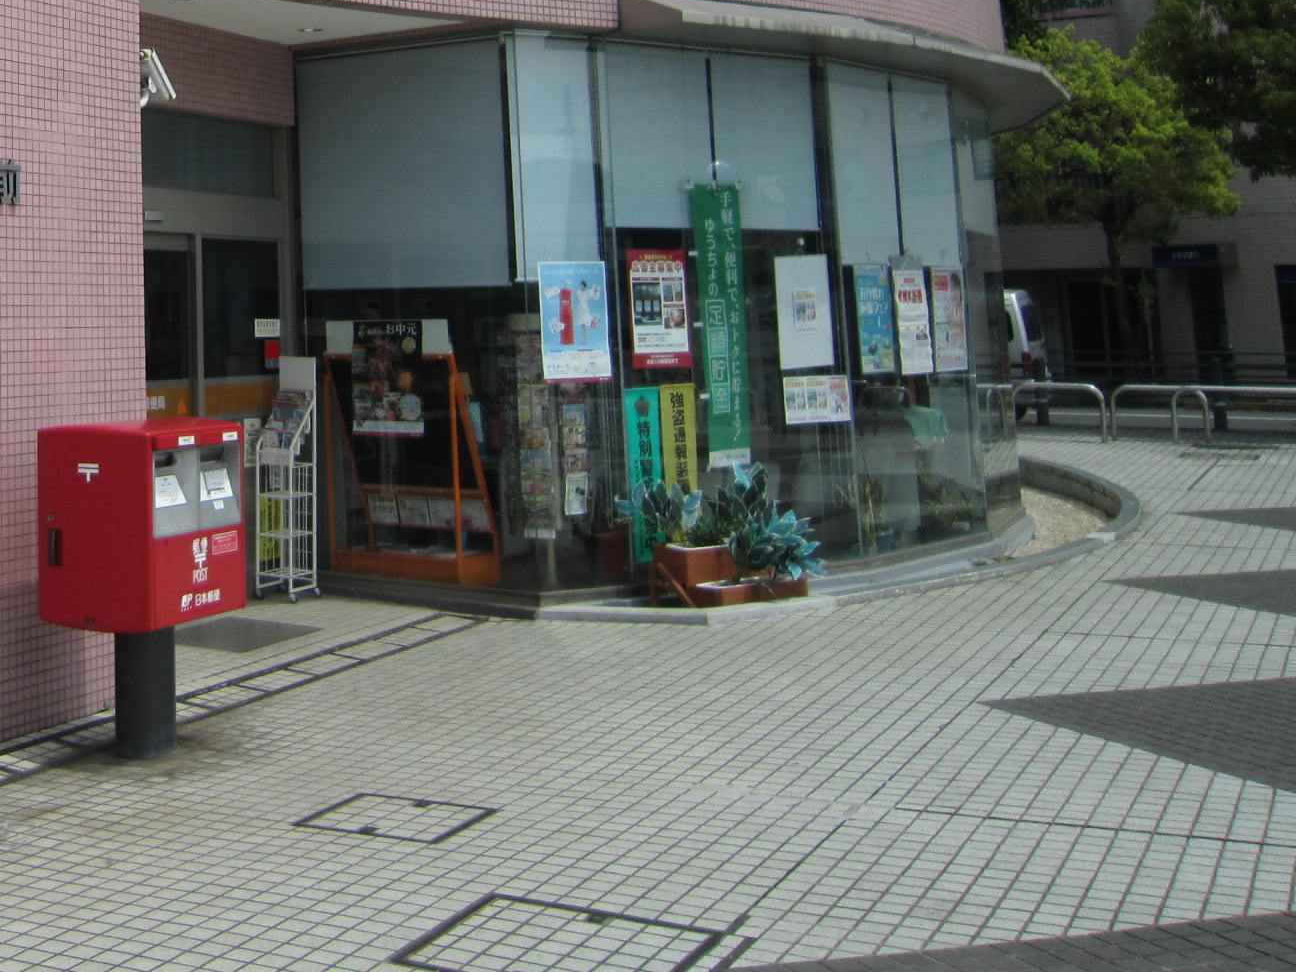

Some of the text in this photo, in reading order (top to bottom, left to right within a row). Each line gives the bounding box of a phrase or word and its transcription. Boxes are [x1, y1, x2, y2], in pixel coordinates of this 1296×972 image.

[385, 322, 418, 336] お中元
[146, 395, 166, 410] 便局
[192, 537, 208, 556] 郵便
[192, 567, 208, 584] POST
[195, 588, 221, 607] 日本郵便
